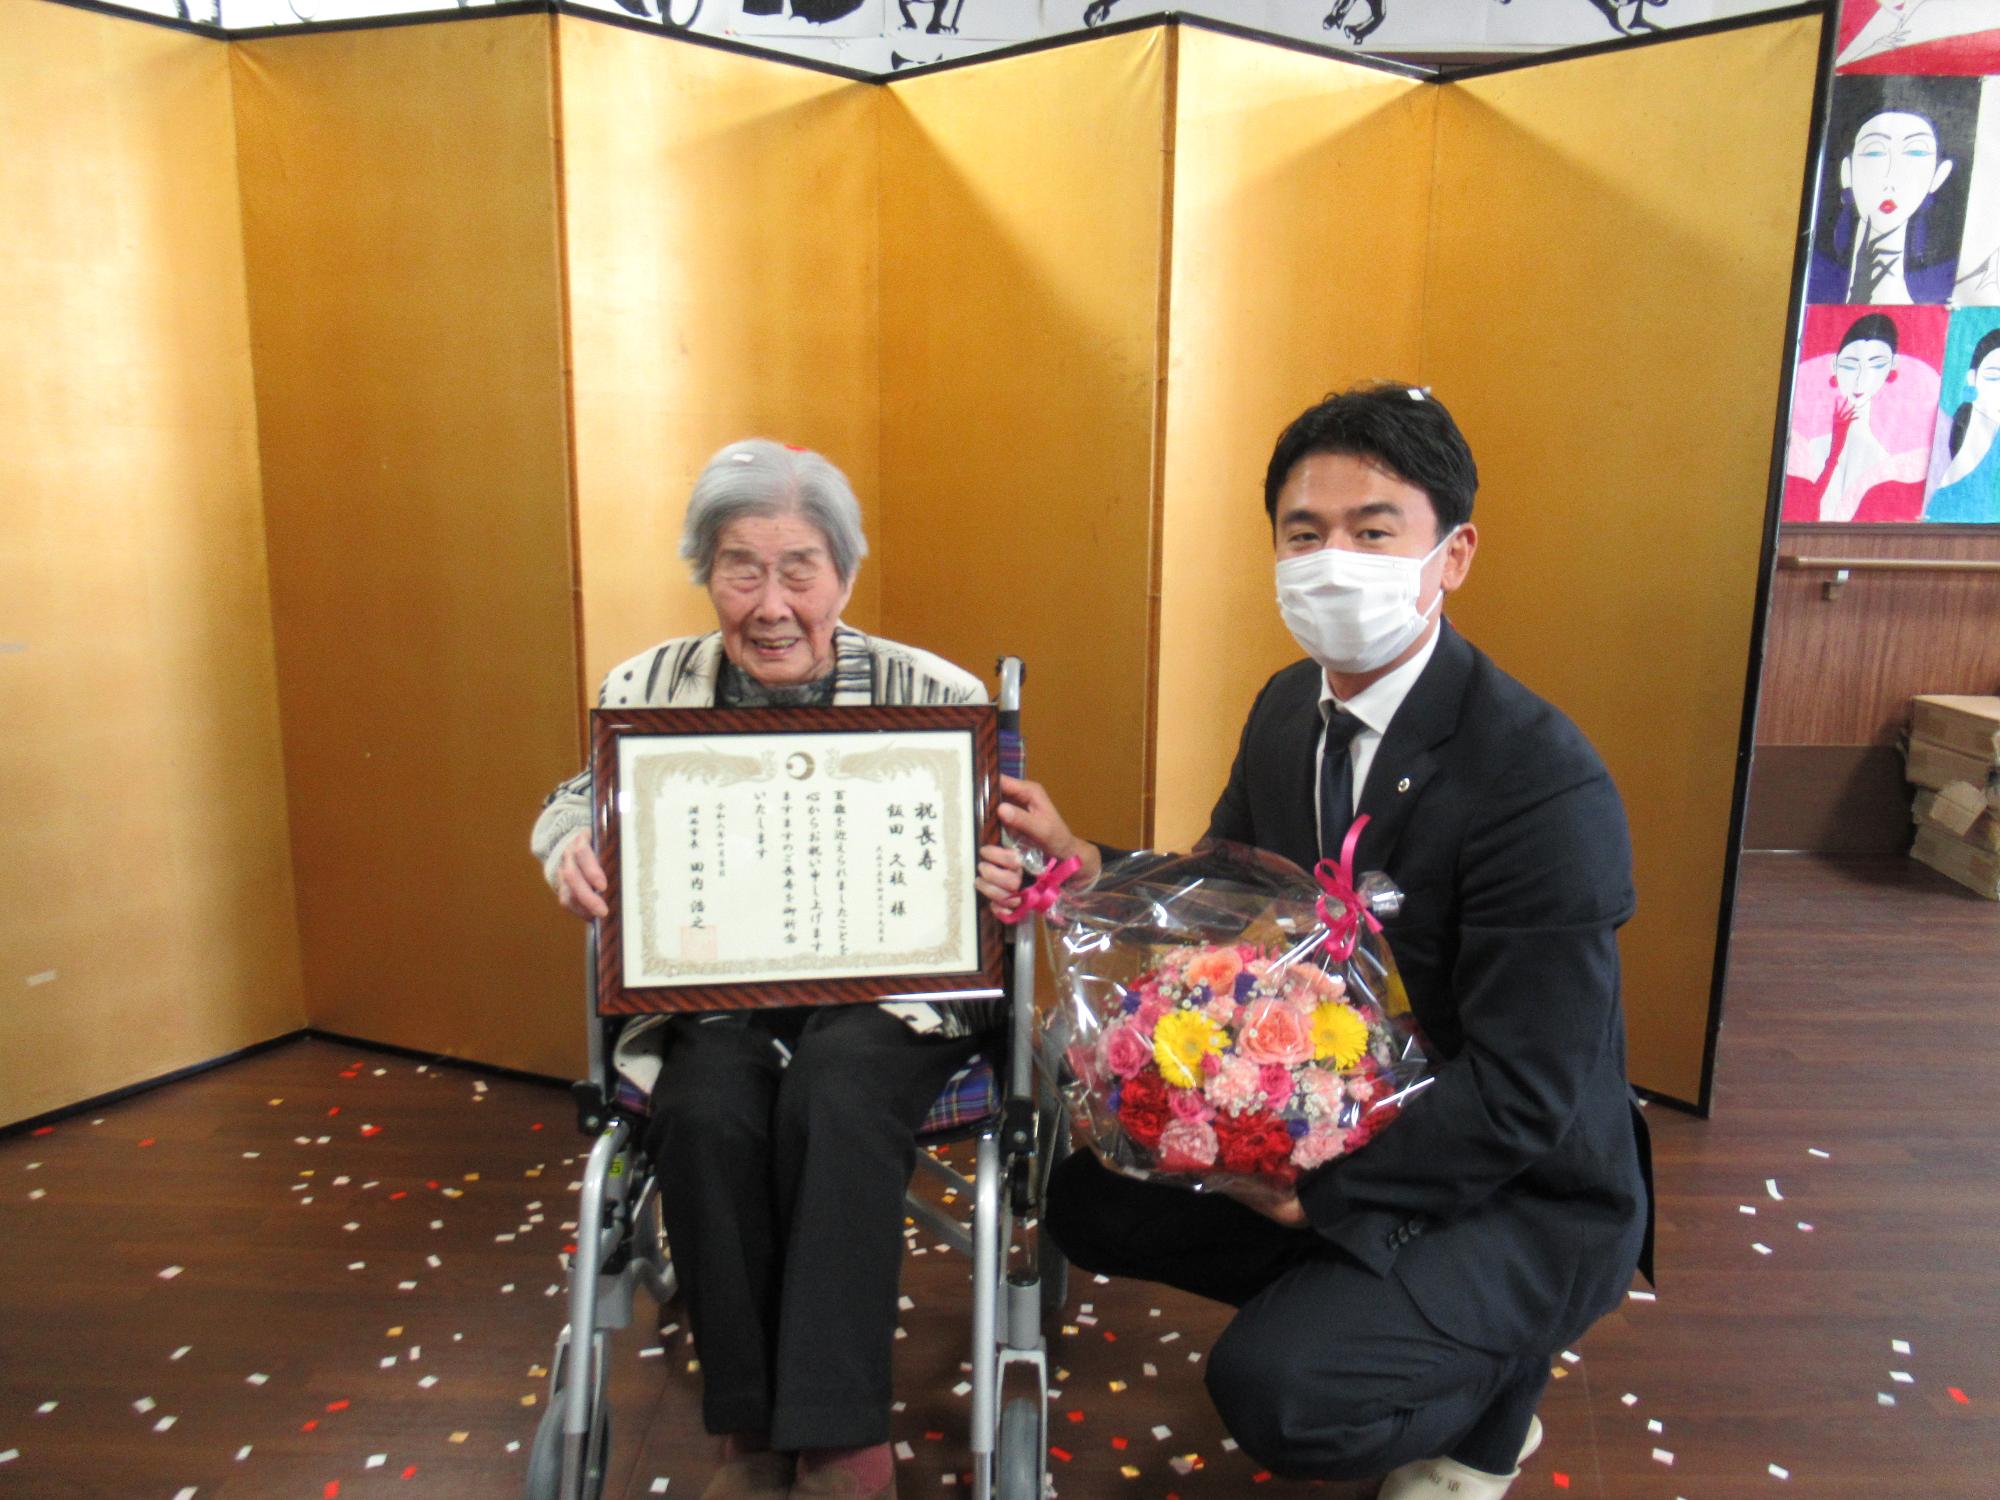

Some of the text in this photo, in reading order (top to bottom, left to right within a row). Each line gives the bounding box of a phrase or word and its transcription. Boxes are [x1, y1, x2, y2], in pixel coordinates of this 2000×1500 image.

[753, 790, 768, 859] いたします
[914, 801, 938, 872] 祝長寿
[805, 791, 824, 952] 心からお祝い申し上げます
[889, 900, 907, 918] 様
